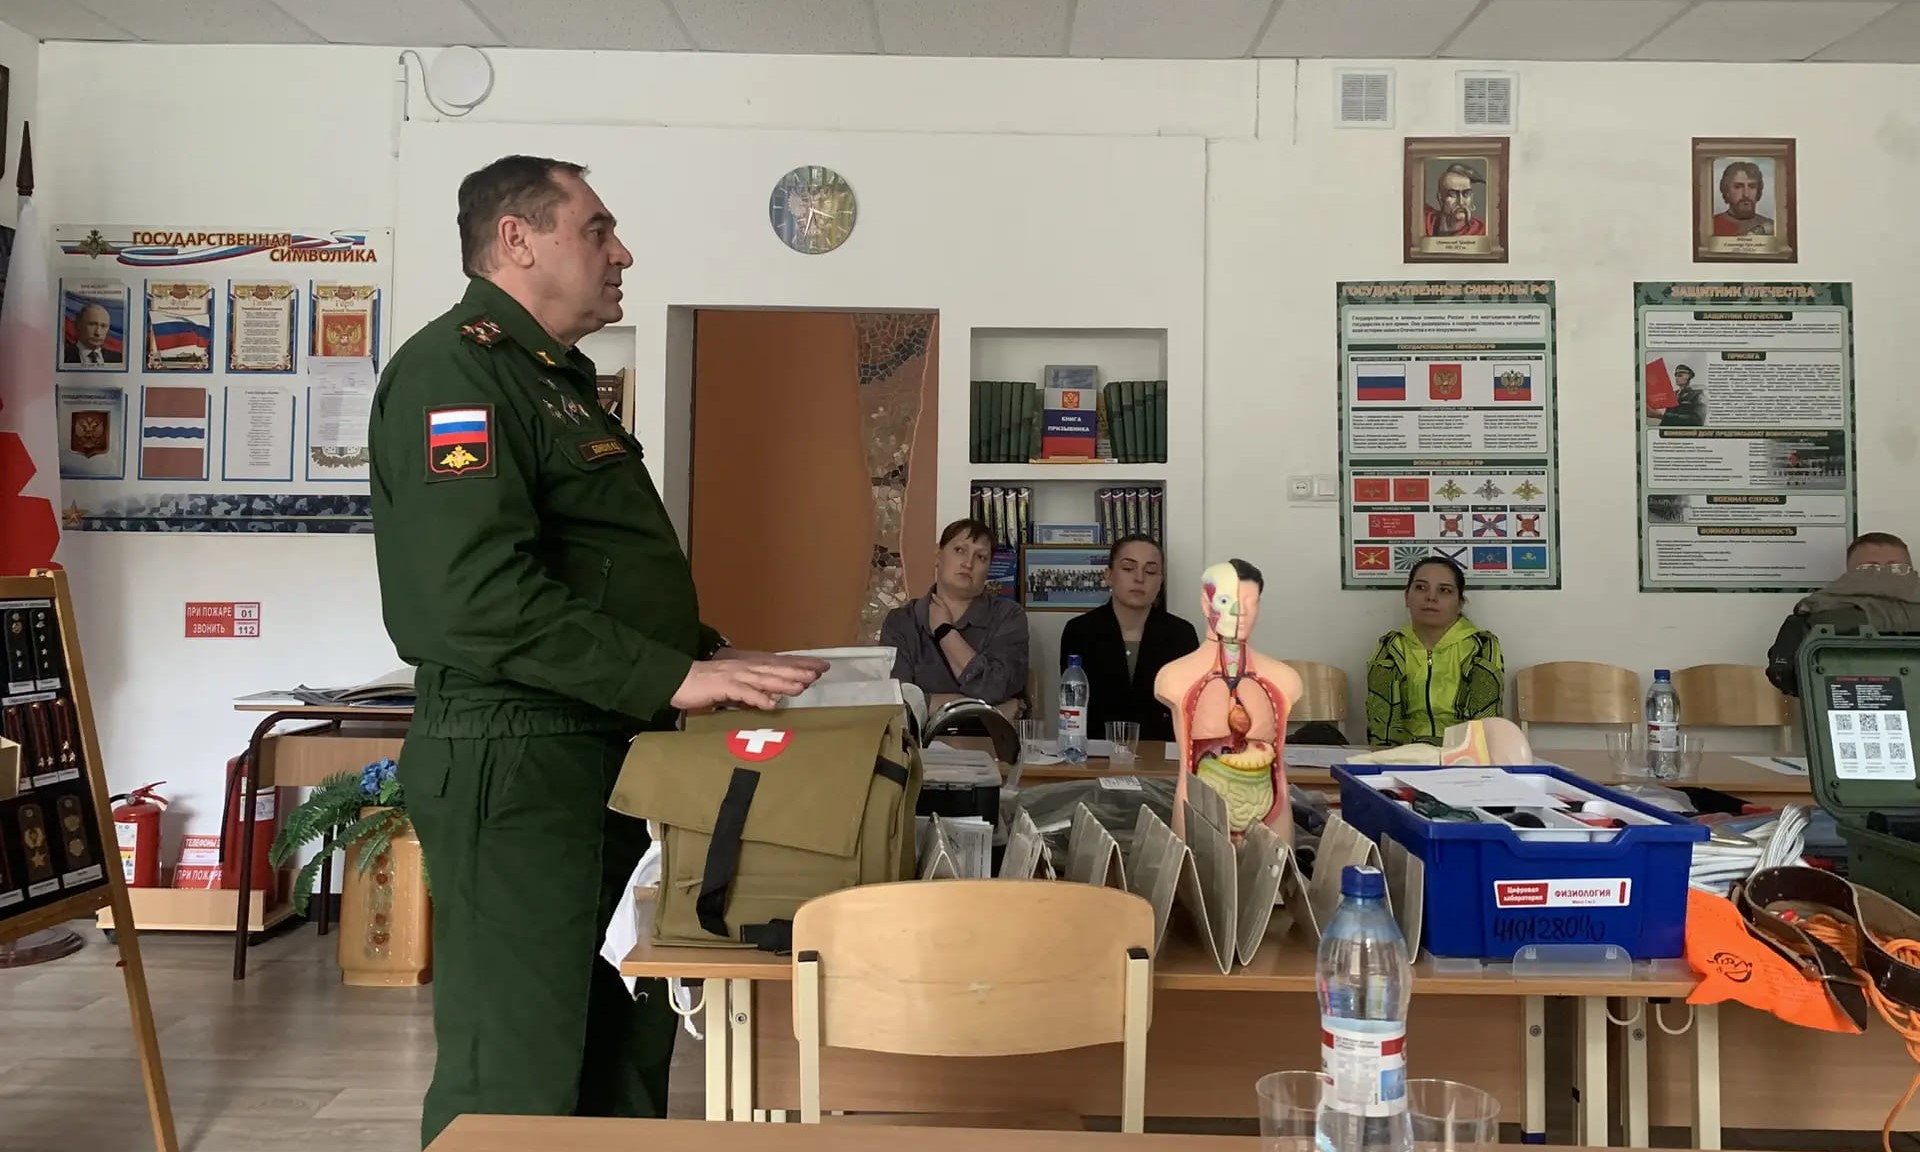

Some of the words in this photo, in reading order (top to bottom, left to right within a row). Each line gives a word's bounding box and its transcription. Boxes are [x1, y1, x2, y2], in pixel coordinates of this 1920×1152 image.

[132, 231, 292, 248] ГОСУДАРСТВЕННАЯ
[269, 248, 378, 263] СИМВОЛИКА
[1464, 284, 1529, 296] СИМВОЛЫ
[1530, 284, 1550, 296] РФ
[1743, 285, 1816, 298] ОТЕЧЕСТВА
[187, 606, 201, 617] ПРИ
[202, 606, 232, 617] ПОЖАРЕ
[241, 609, 253, 618] 01
[192, 623, 226, 634] ЗВОНИТЬ
[238, 625, 255, 635] 112
[185, 838, 217, 848] ТЕЛЕФОНЫ
[176, 869, 192, 881] ПРИ
[1554, 889, 1612, 898] ФИЗИОЛОГИЯ
